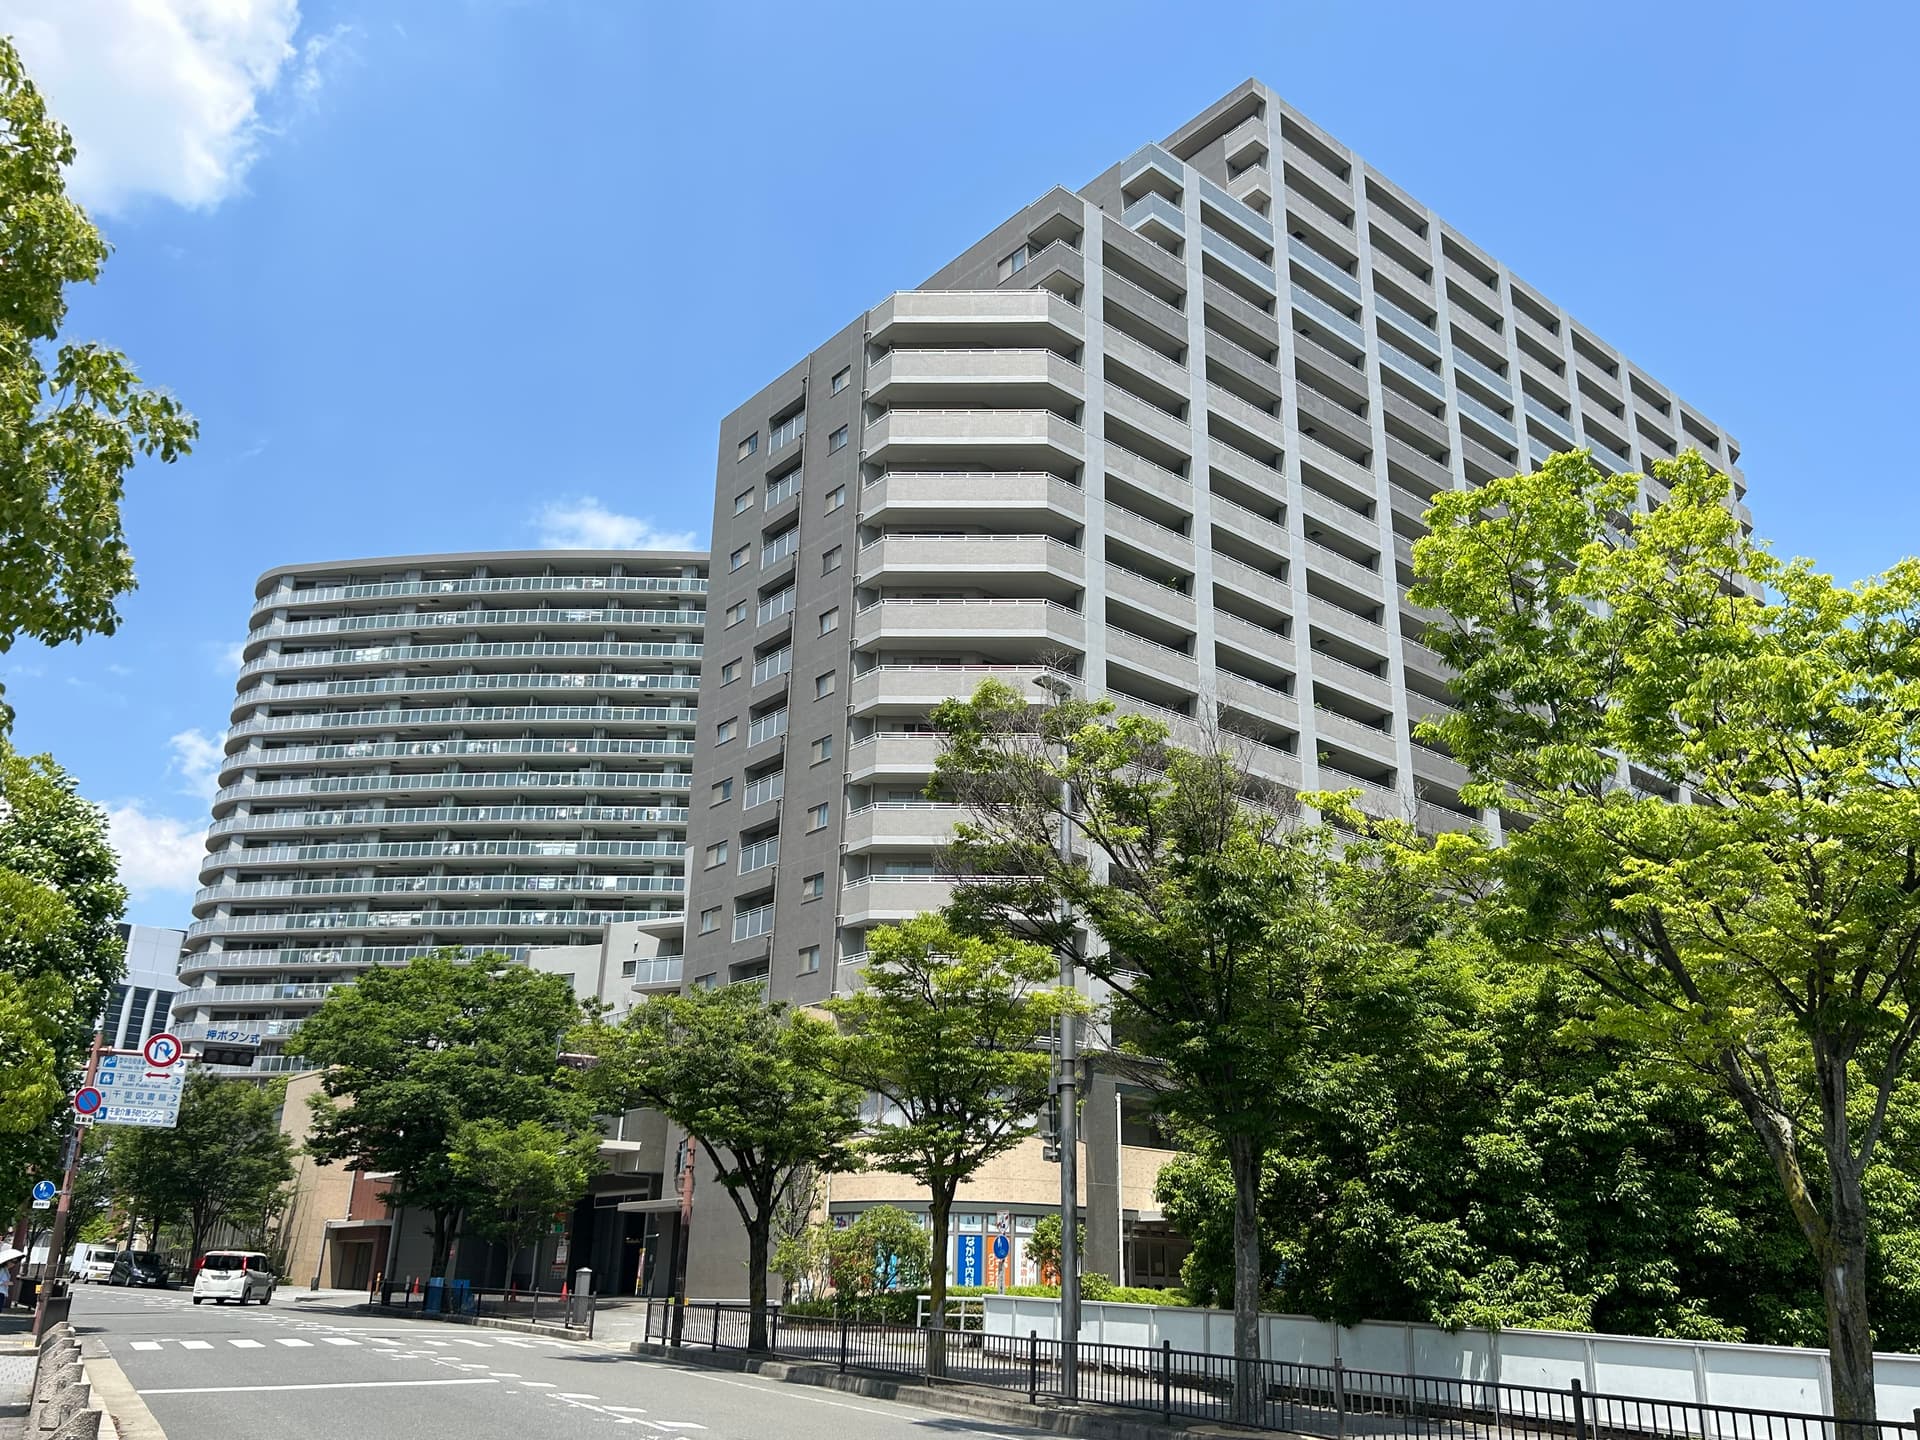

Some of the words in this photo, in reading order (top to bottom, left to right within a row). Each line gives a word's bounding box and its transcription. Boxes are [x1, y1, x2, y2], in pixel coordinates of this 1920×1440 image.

[206, 1029, 261, 1044] 押ボタン式
[965, 1236, 975, 1287] ながや内科
